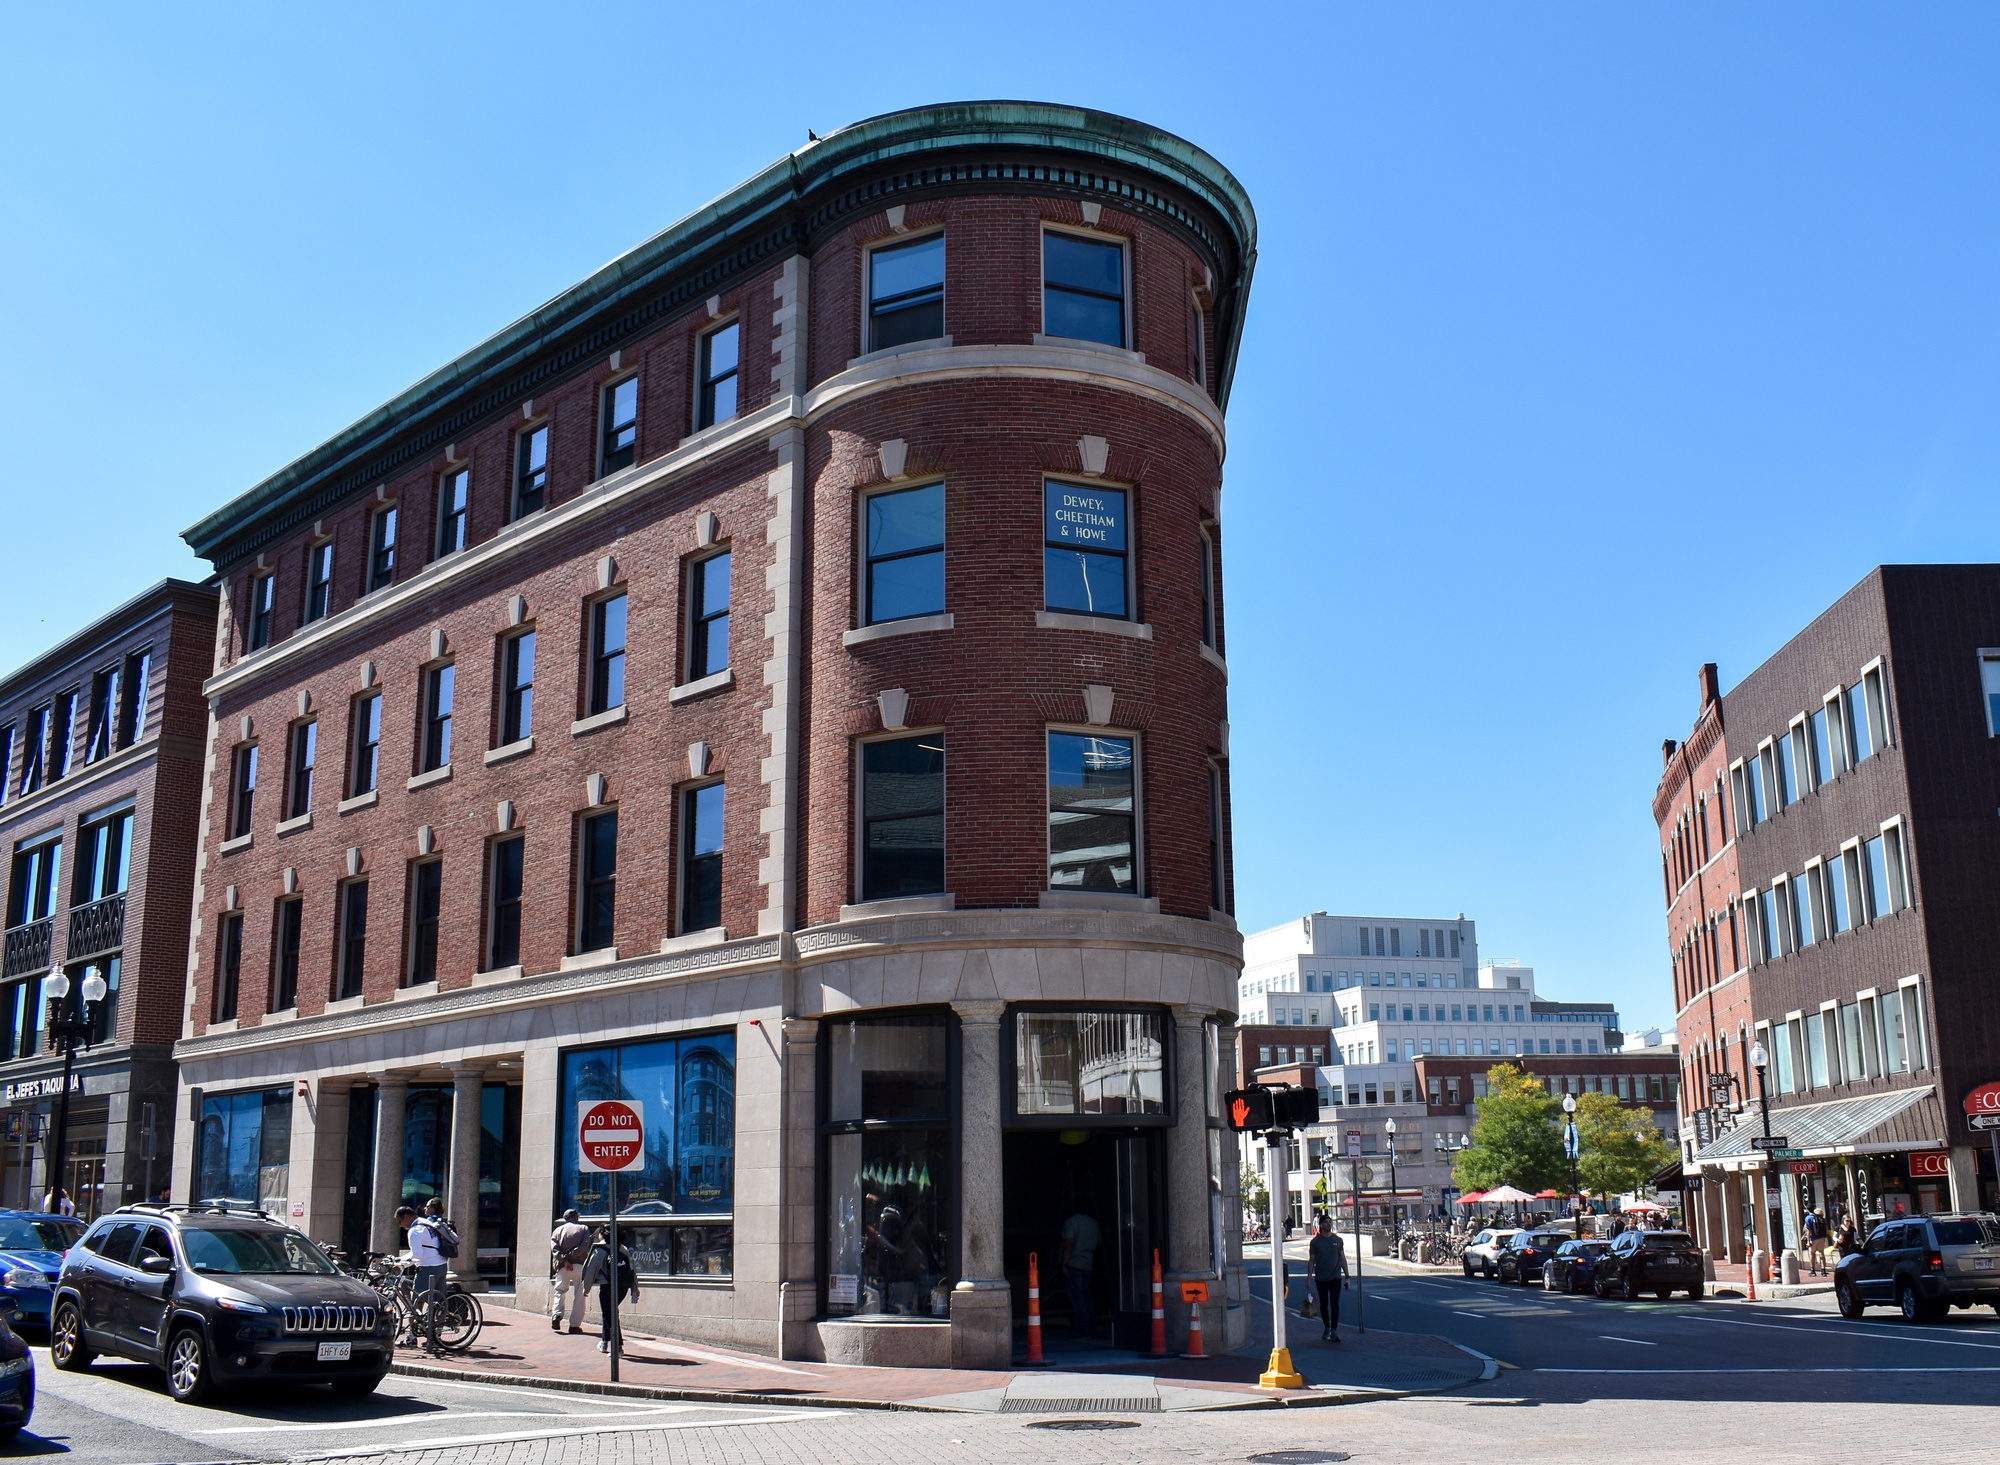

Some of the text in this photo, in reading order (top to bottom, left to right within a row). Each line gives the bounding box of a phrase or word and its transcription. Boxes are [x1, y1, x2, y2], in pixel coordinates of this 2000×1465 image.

[1063, 495, 1104, 511] DEWEY,
[1055, 509, 1115, 528] CHEETHAM
[1061, 525, 1106, 541] & HOWE
[1711, 1076, 1729, 1085] BAR
[6, 1085, 15, 1099] EL
[15, 1081, 40, 1098] JEFE'S
[589, 1115, 633, 1126] DO NOT
[1699, 1112, 1710, 1140] BREW
[1305, 1126, 1323, 1135] ONE
[594, 1145, 630, 1157] ENTER
[1795, 1163, 1814, 1172] COOP
[340, 1347, 349, 1356] 66
